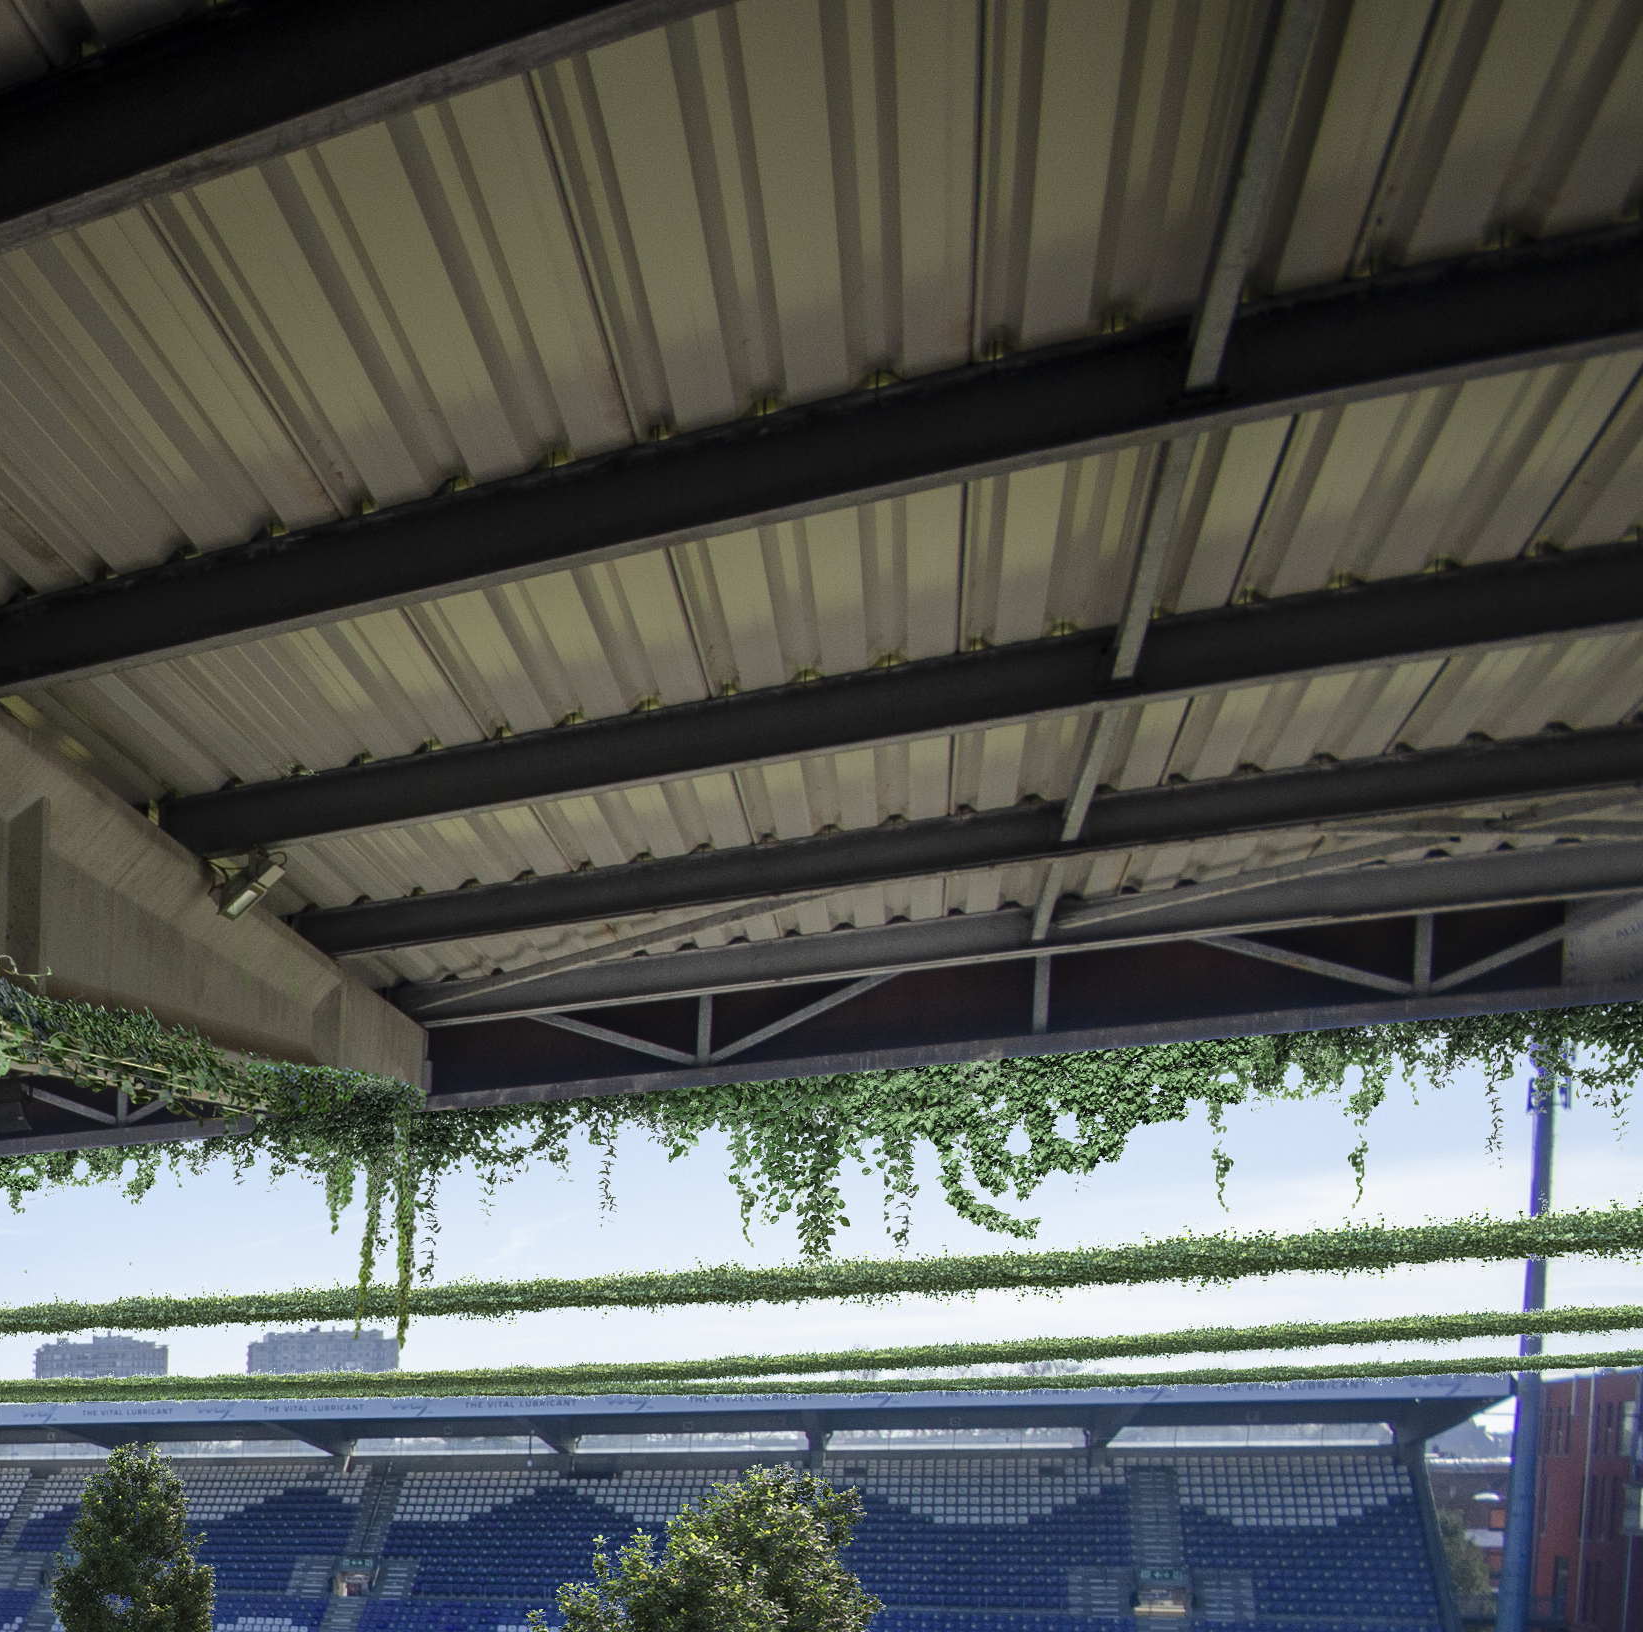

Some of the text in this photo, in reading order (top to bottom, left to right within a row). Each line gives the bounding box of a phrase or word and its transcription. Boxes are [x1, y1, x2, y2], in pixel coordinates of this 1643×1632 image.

[264, 1404, 365, 1413] THE VITAL LUBRICANT
[466, 1400, 577, 1409] THE VITAL LUBRICANT
[82, 1408, 173, 1417] THE VITAL LUBRICANT
